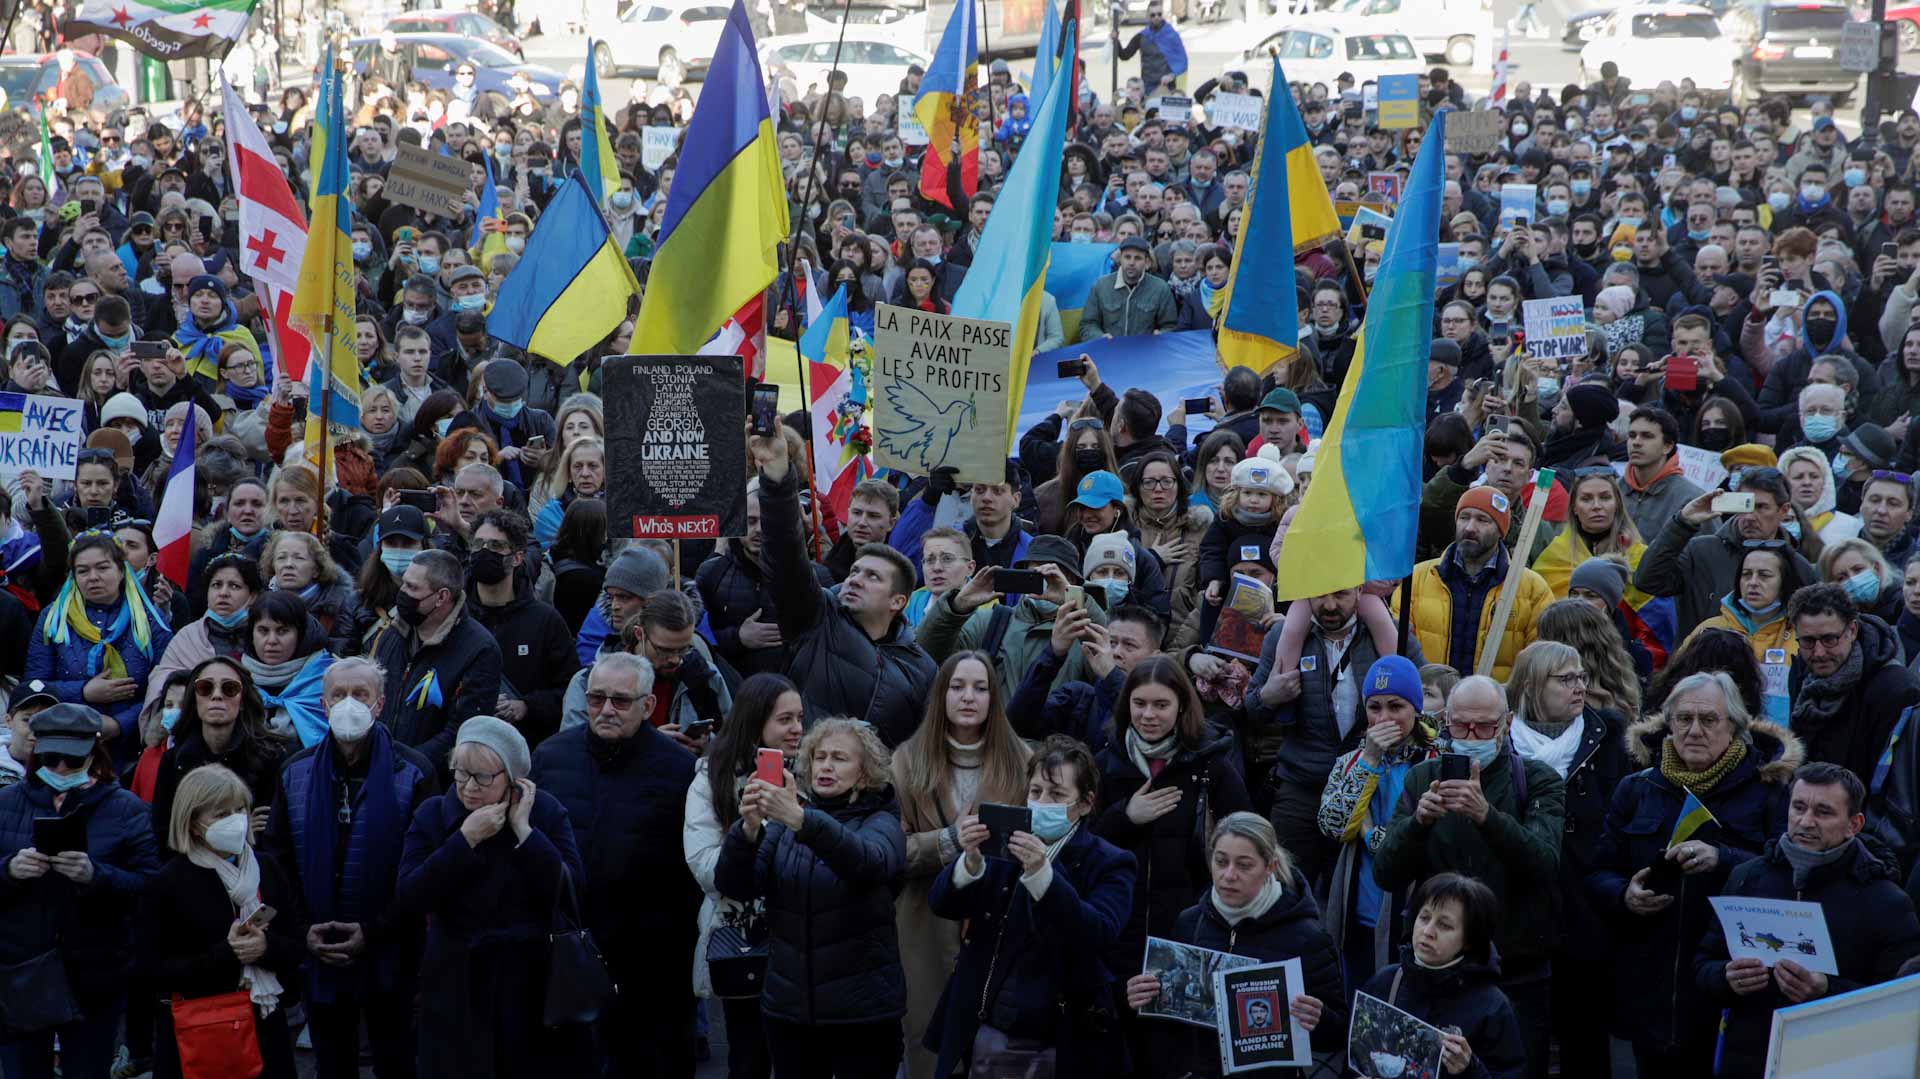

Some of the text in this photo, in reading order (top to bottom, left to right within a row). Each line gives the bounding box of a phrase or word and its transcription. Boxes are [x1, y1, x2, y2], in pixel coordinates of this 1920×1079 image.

[877, 309, 1010, 348] LA PAIX PASSE
[910, 341, 972, 366] AVANT
[1527, 336, 1587, 358] STOP WAR!
[882, 357, 1002, 392] LES PROFITS
[24, 401, 78, 433] AVEC
[647, 418, 704, 431] GEORGIA
[642, 430, 705, 444] AND NOW
[641, 444, 710, 460] UKRAINE
[638, 517, 674, 534] Who's
[1231, 979, 1280, 990] STOP RUSSIAN
[1234, 1033, 1289, 1047] HANDS OFF
[1240, 1041, 1285, 1053] UKRAINE
